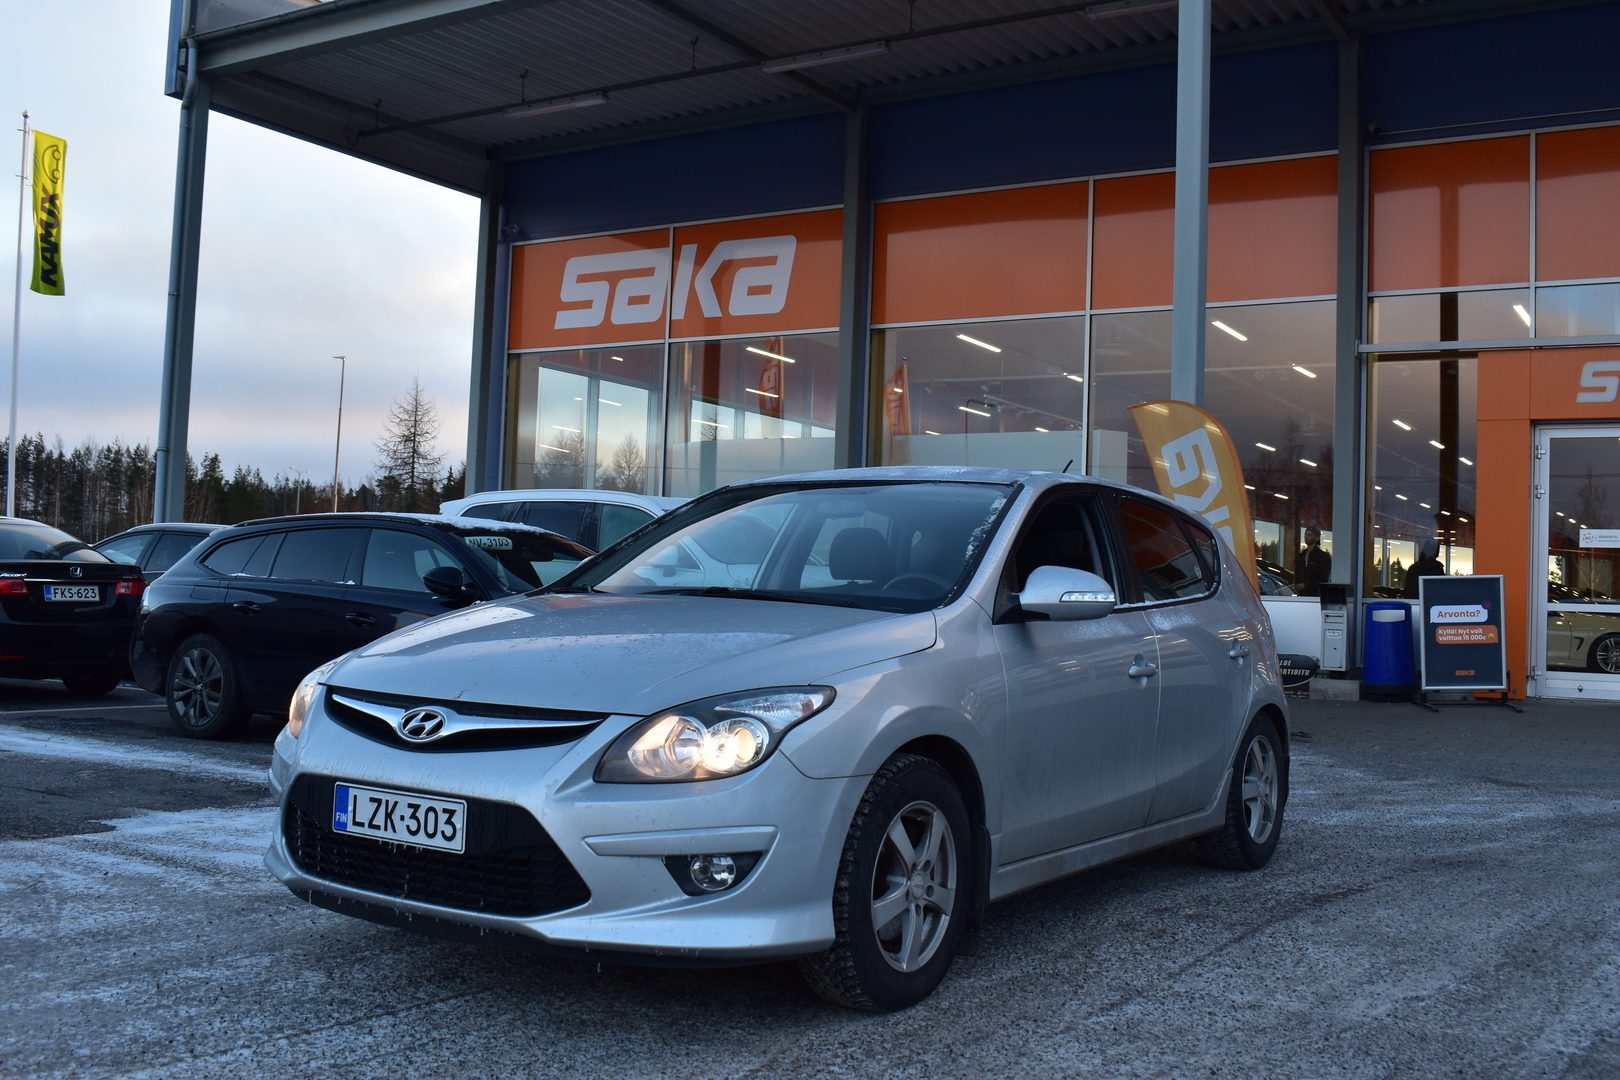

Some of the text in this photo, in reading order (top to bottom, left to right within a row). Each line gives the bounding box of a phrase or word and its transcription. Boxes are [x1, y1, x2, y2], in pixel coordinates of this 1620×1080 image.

[40, 182, 60, 287] KAMUX
[53, 588, 97, 599] FKS-623
[336, 794, 458, 842] FIN LZK-303
